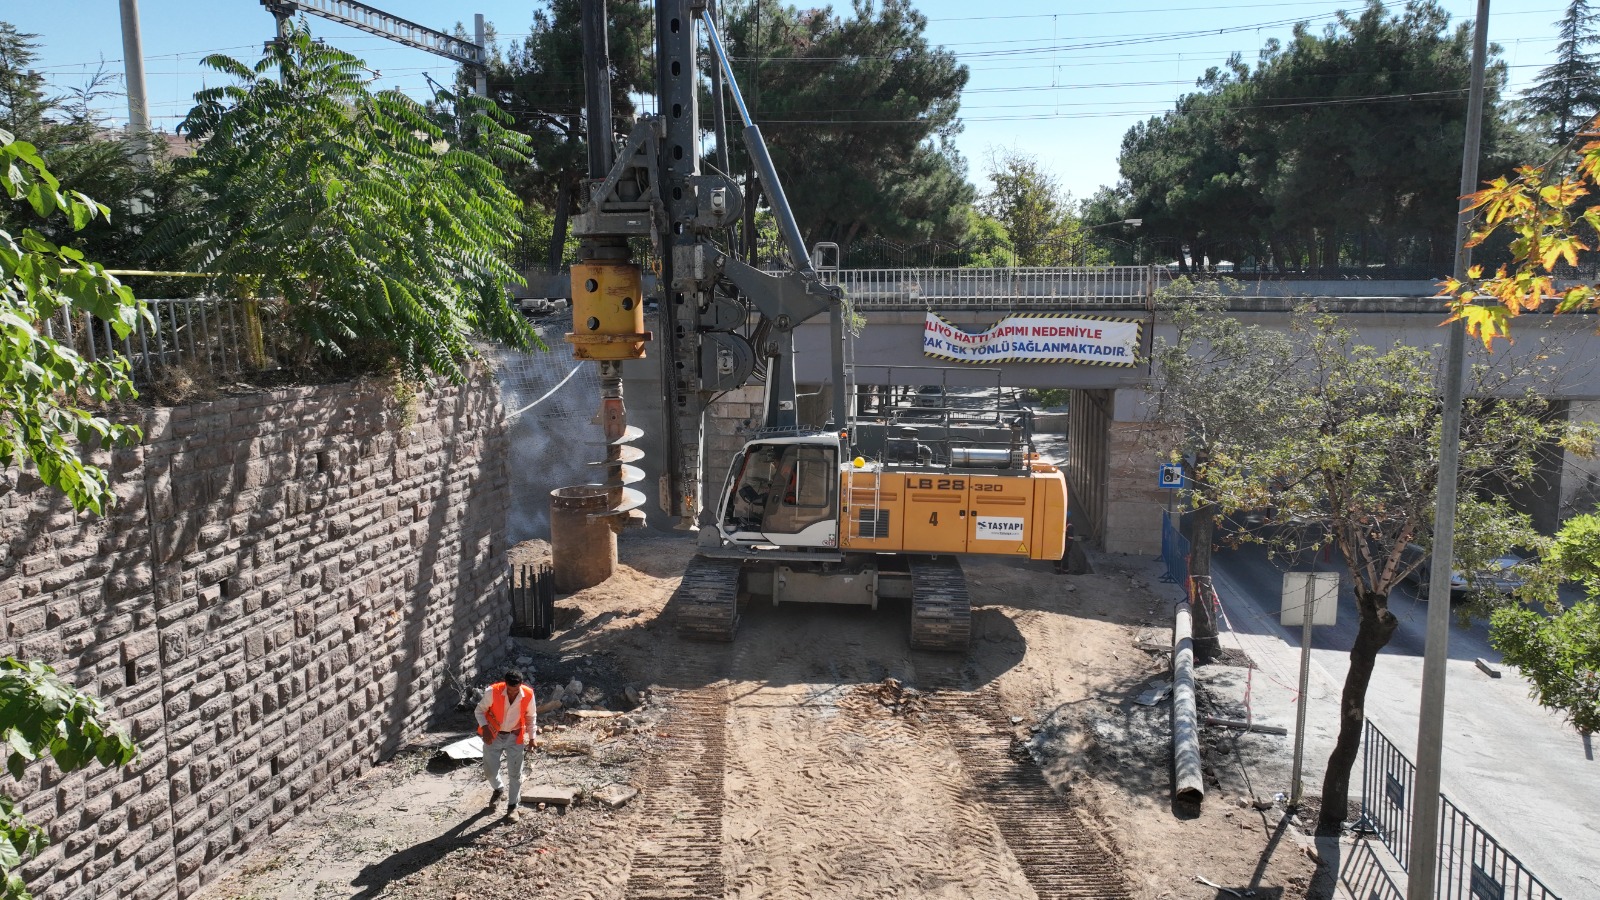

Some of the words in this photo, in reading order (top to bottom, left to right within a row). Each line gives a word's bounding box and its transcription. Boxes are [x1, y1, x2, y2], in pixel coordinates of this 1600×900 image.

[954, 331, 989, 344] HATTI
[992, 326, 1028, 338] YAPIMI
[1032, 325, 1103, 339] NEDENİYLE
[945, 341, 967, 355] TEK
[971, 340, 1010, 355] YÖNLÜ
[906, 478, 933, 490] LB
[929, 511, 939, 527] 4
[987, 522, 1023, 531] TAŞYAPI
